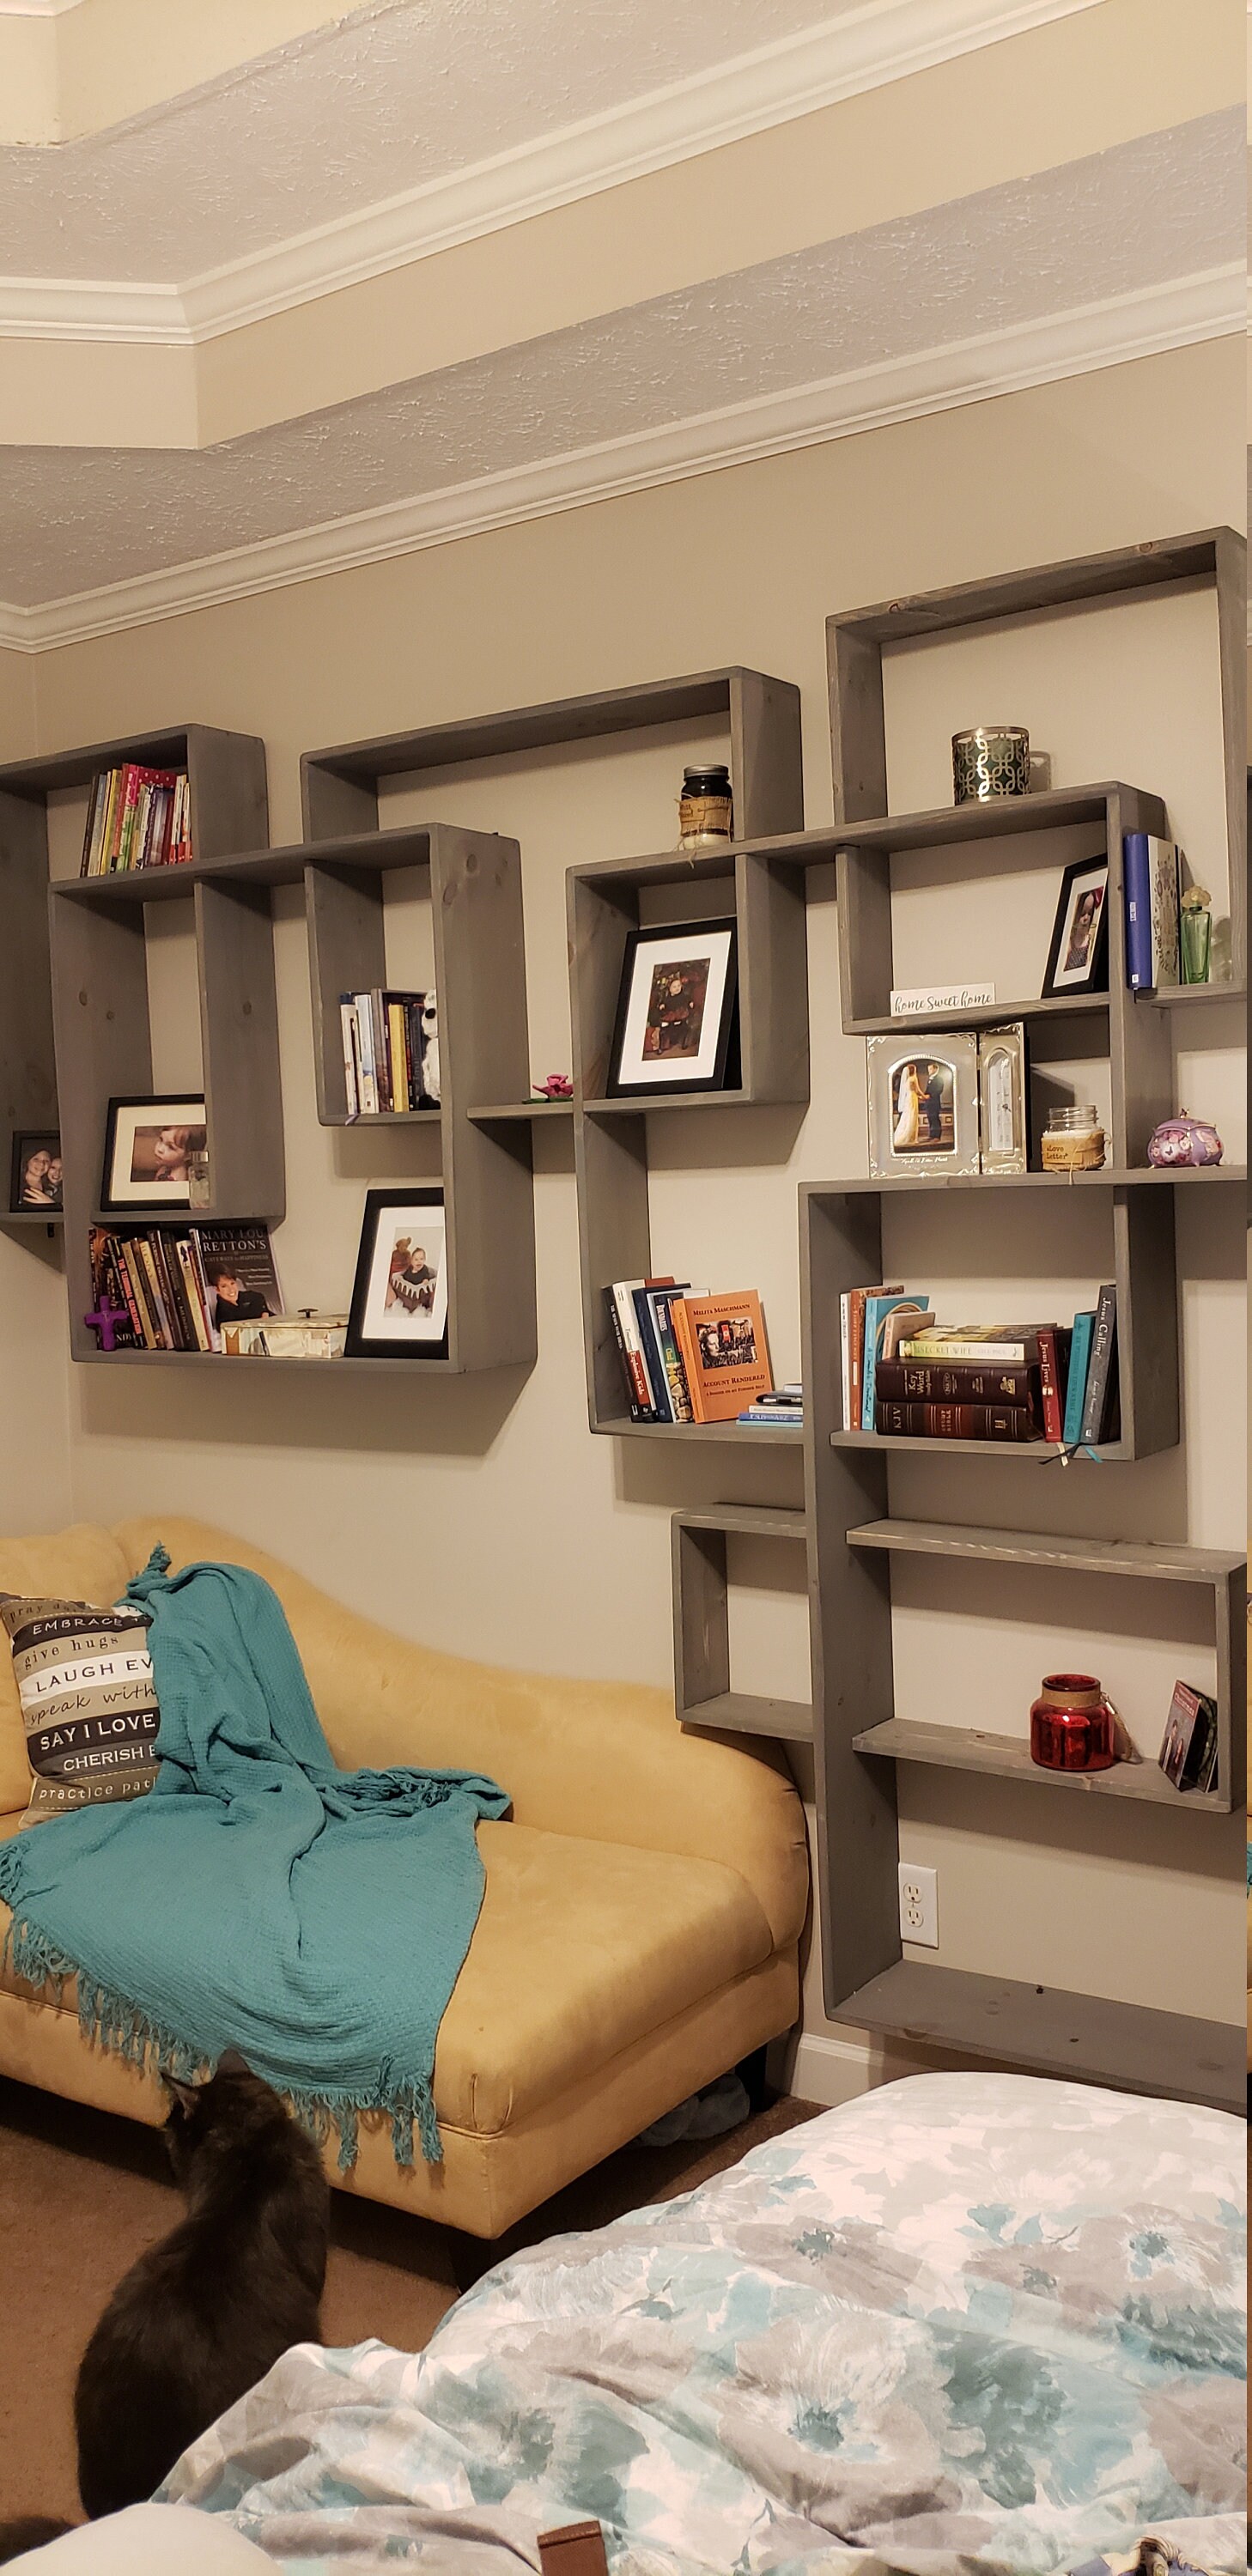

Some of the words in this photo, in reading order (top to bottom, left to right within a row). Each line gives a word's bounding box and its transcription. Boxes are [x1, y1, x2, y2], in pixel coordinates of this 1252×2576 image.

[895, 996, 925, 1013] home
[960, 990, 993, 1007] home
[202, 1230, 235, 1241] MARY
[240, 1228, 264, 1239] LOU
[203, 1240, 267, 1252] RETTON'S
[1100, 1297, 1111, 1320] Jesus
[1093, 1323, 1108, 1357] Calling
[1039, 1342, 1048, 1362] Jesus
[629, 1352, 641, 1383] Explosive
[1041, 1364, 1050, 1382] Lives
[702, 1379, 730, 1388] ACCOUNT
[731, 1374, 765, 1385] RENDERED
[909, 1374, 917, 1390] Key
[893, 1406, 902, 1429] KJV
[9, 1605, 43, 1624] pray
[33, 1618, 124, 1635] EMBRACE
[24, 1646, 60, 1671] give
[71, 1636, 119, 1649] hugs
[36, 1662, 114, 1692] LAUGH
[30, 1694, 91, 1725] speak
[103, 1683, 156, 1704] with
[40, 1727, 76, 1751] SAY
[84, 1724, 91, 1739] I
[97, 1714, 155, 1735] LOVE
[64, 1746, 143, 1771] CHERISH
[39, 1784, 113, 1801] practice
